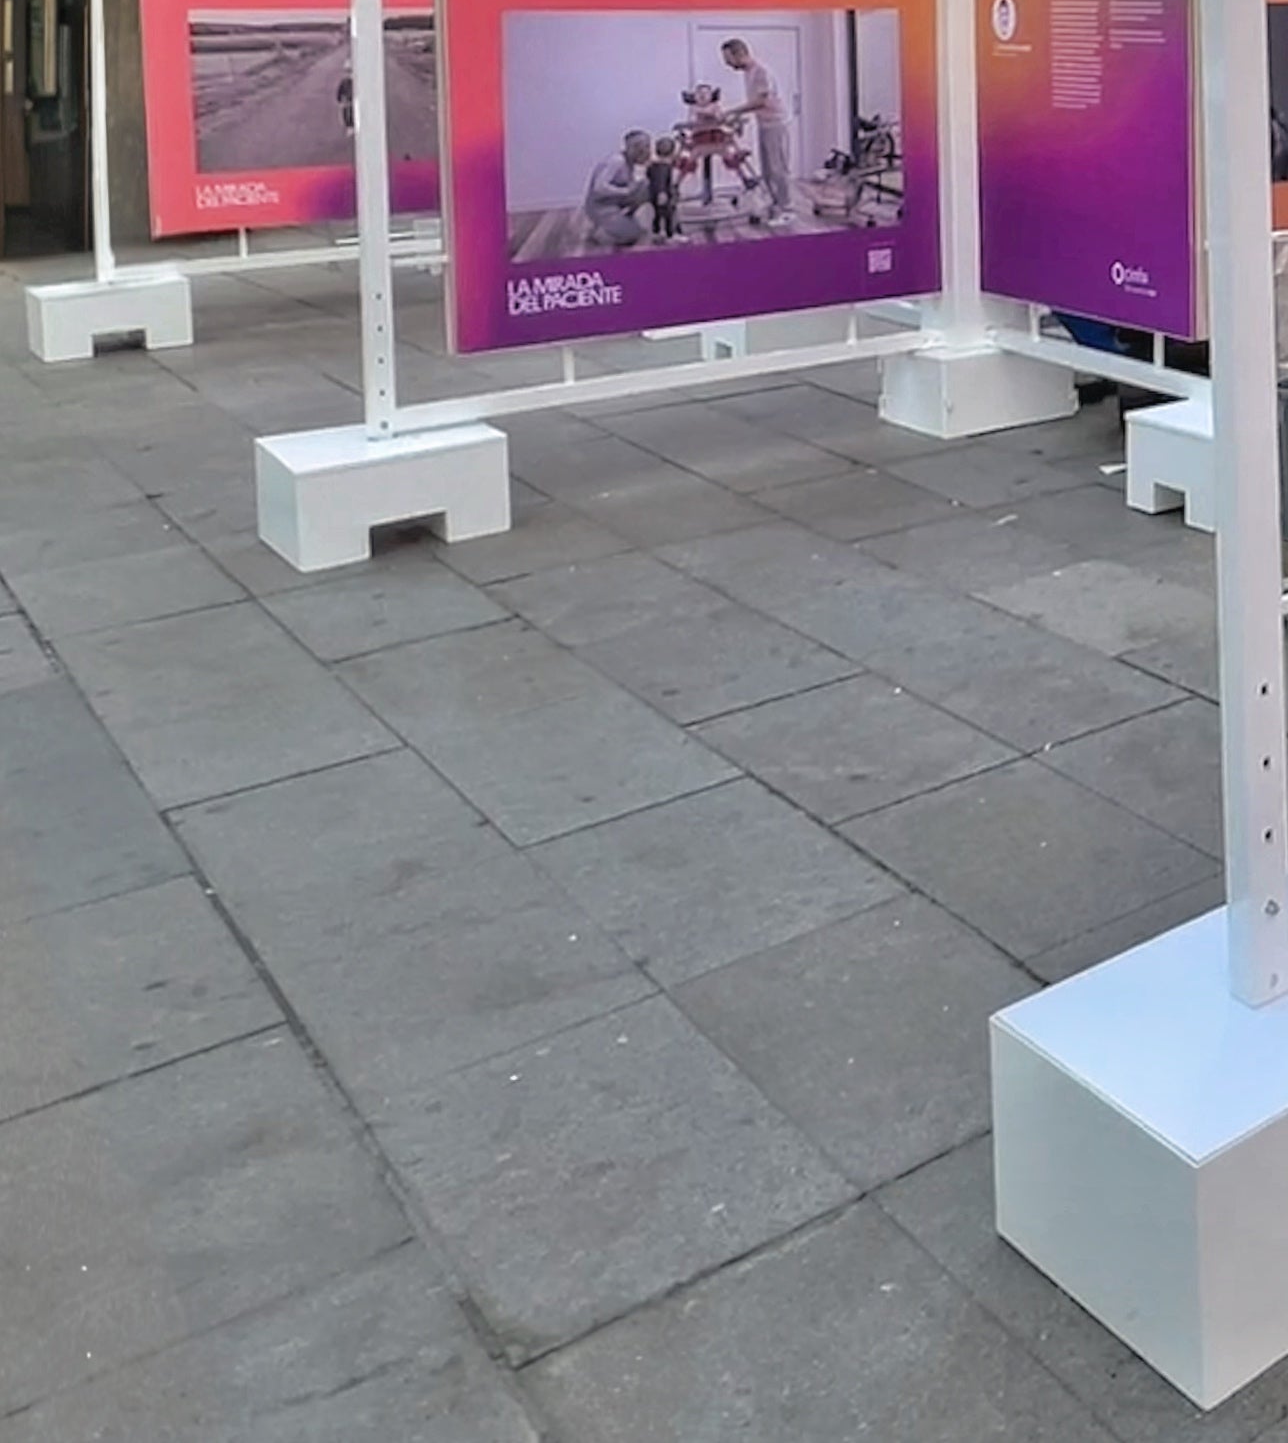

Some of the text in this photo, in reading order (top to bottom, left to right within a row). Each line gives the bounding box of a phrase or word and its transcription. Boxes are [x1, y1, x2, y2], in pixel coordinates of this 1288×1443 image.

[507, 271, 604, 295] LA MIRADA
[543, 284, 622, 311] PACIENTE
